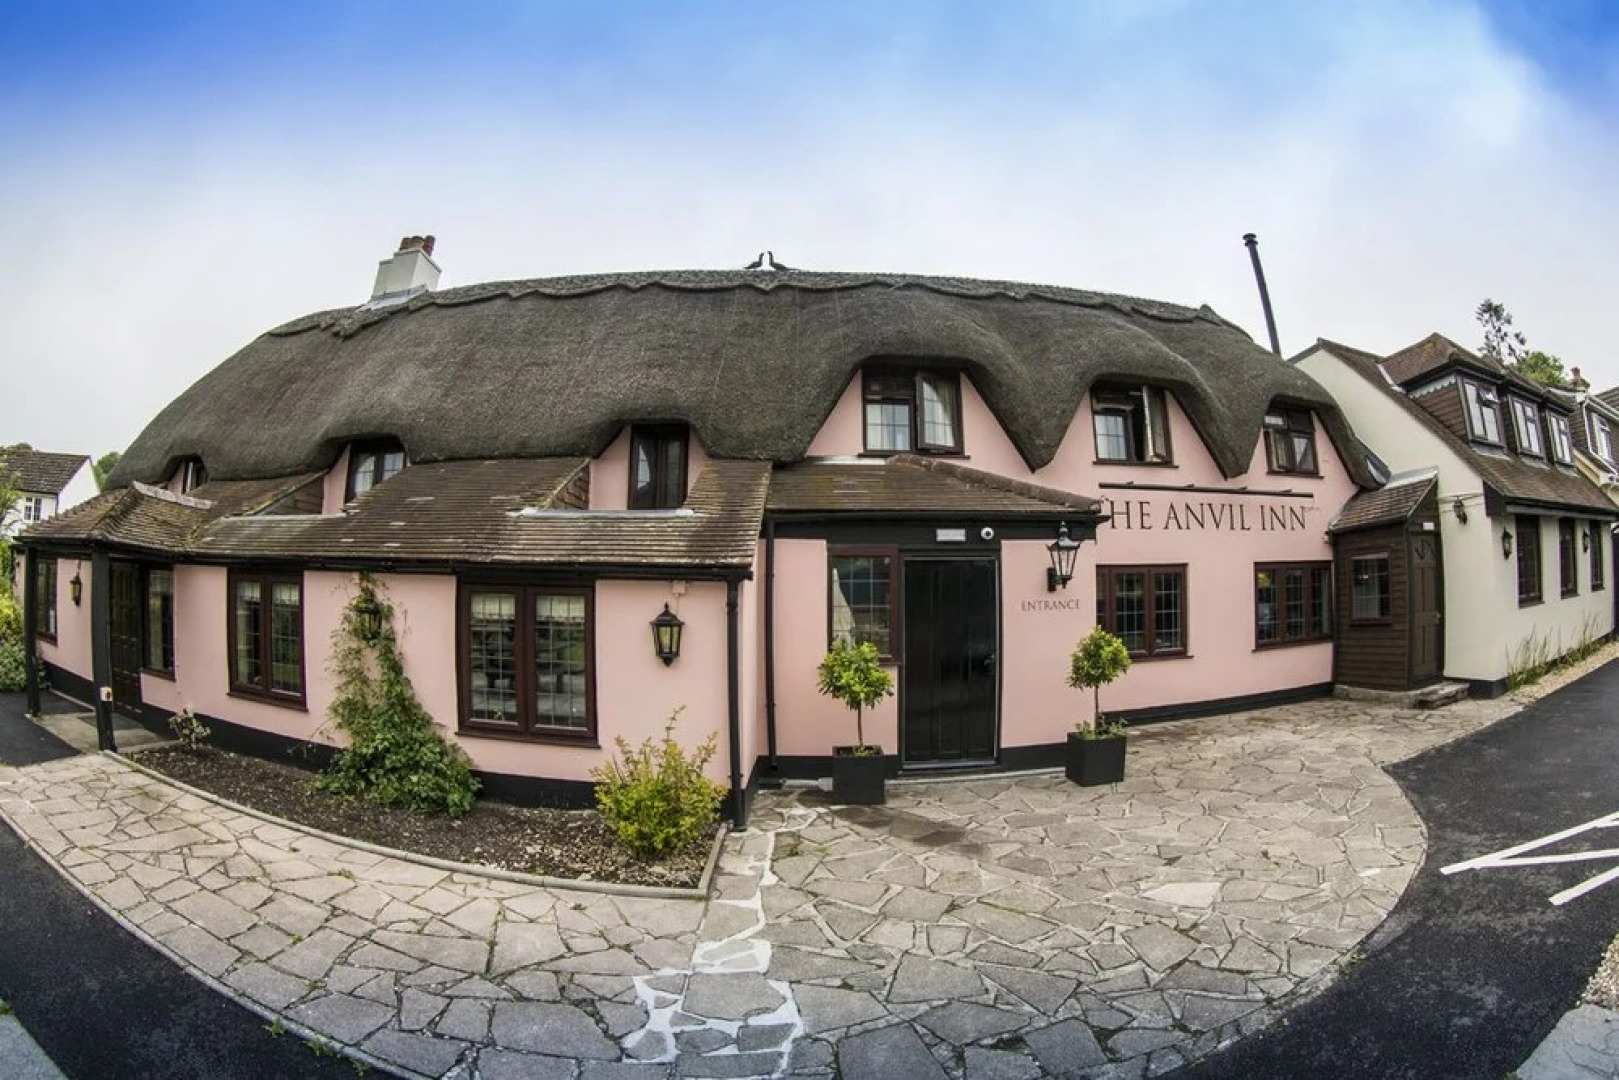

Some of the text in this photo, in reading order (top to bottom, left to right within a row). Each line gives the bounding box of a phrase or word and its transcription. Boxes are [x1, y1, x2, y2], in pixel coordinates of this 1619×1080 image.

[1105, 499, 1307, 531] HE ANVIL INN
[1021, 599, 1080, 611] ENTRANCE
